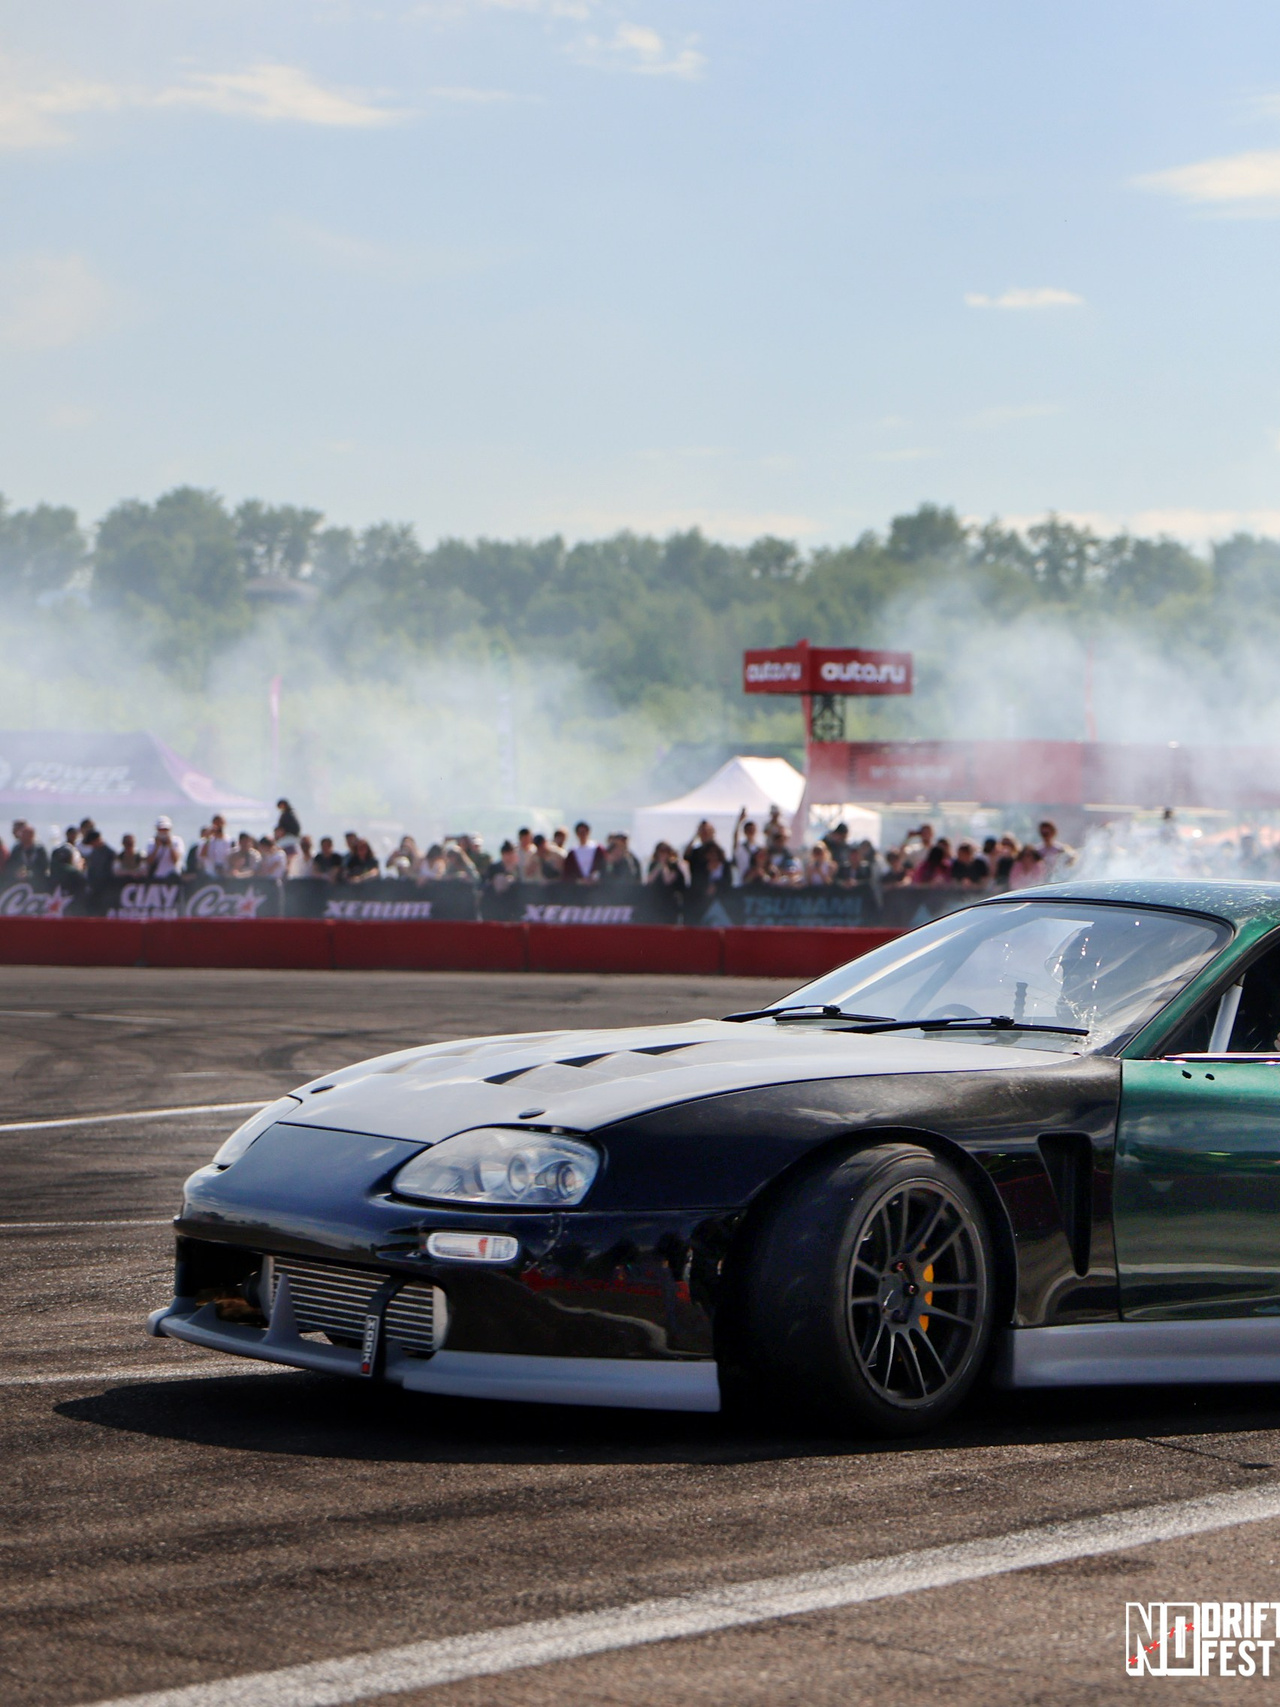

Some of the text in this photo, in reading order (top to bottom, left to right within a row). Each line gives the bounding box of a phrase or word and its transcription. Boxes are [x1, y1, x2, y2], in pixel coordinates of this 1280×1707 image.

[746, 660, 801, 682] auto.ru
[820, 661, 906, 684] auto.ru
[120, 883, 179, 908] CLAY
